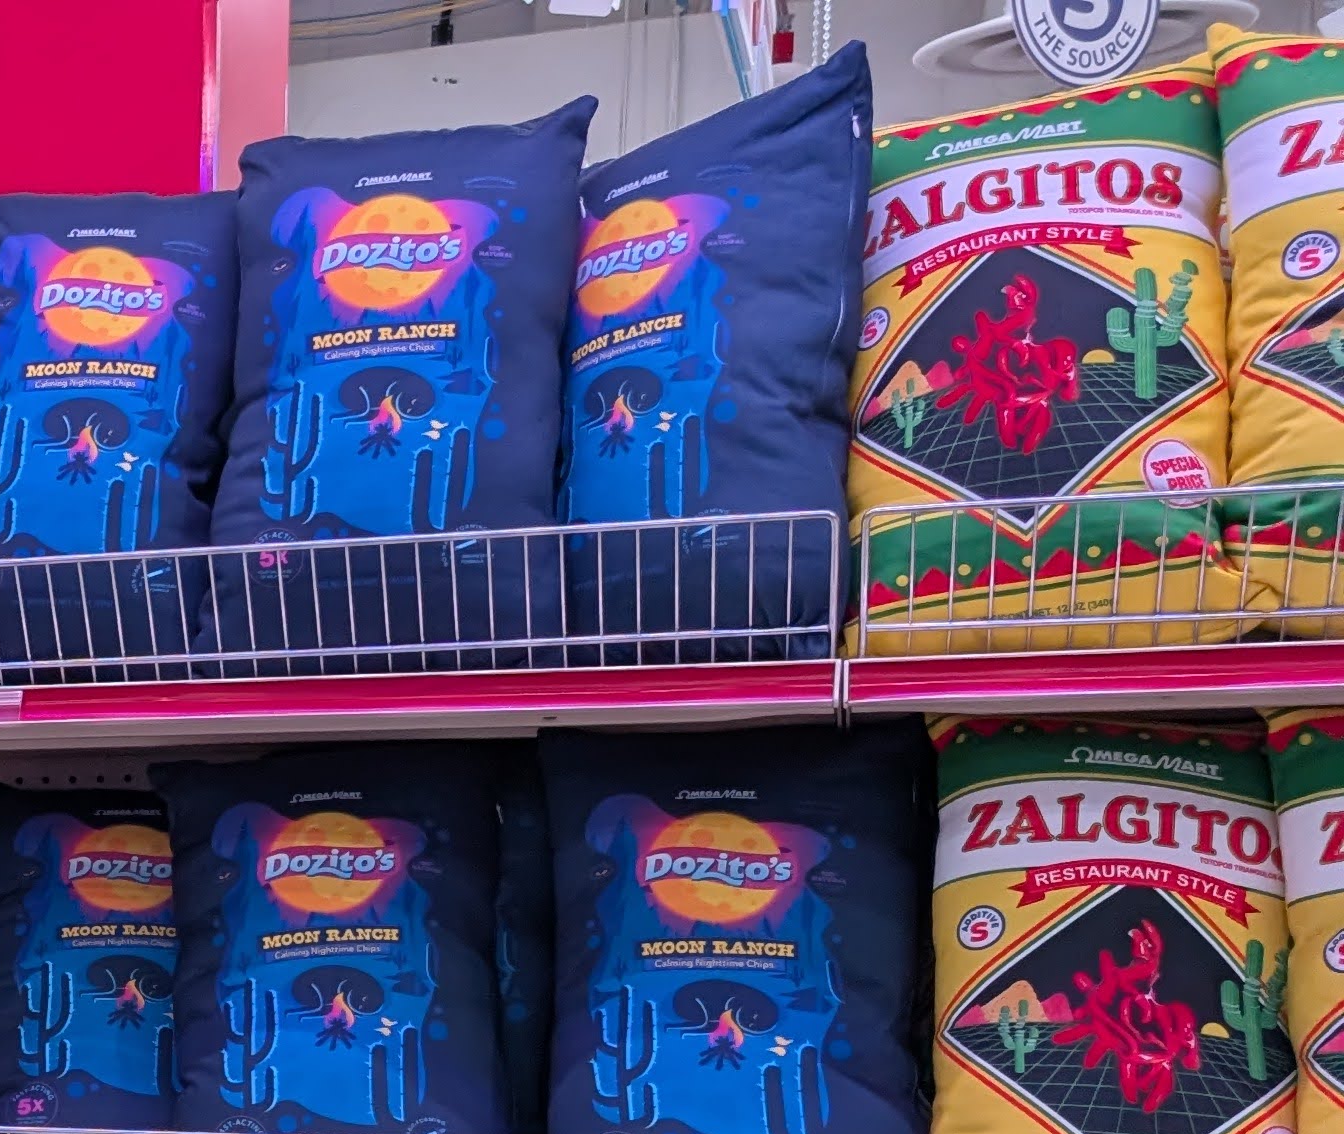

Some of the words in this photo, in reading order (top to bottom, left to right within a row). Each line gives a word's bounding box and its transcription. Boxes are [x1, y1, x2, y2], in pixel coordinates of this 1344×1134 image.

[1034, 12, 1062, 57] THE
[1067, 22, 1136, 68] SOURCE
[321, 236, 461, 271] Dozito's
[577, 231, 688, 282] Dozito's
[912, 229, 1040, 275] RESTAURANT
[1044, 226, 1114, 242] STYLE
[312, 331, 373, 350] MOON
[378, 322, 457, 343] RANCH
[1150, 456, 1203, 478] SPECIAL
[962, 794, 1282, 866] ZALGITO
[264, 849, 395, 878] Dozito's
[644, 852, 792, 883] Dozito's
[1035, 864, 1172, 886] RESTAURANT
[1176, 869, 1238, 903] STYLE
[970, 922, 987, 942] S
[642, 941, 708, 956] MOON
[713, 941, 794, 958] RANCH
